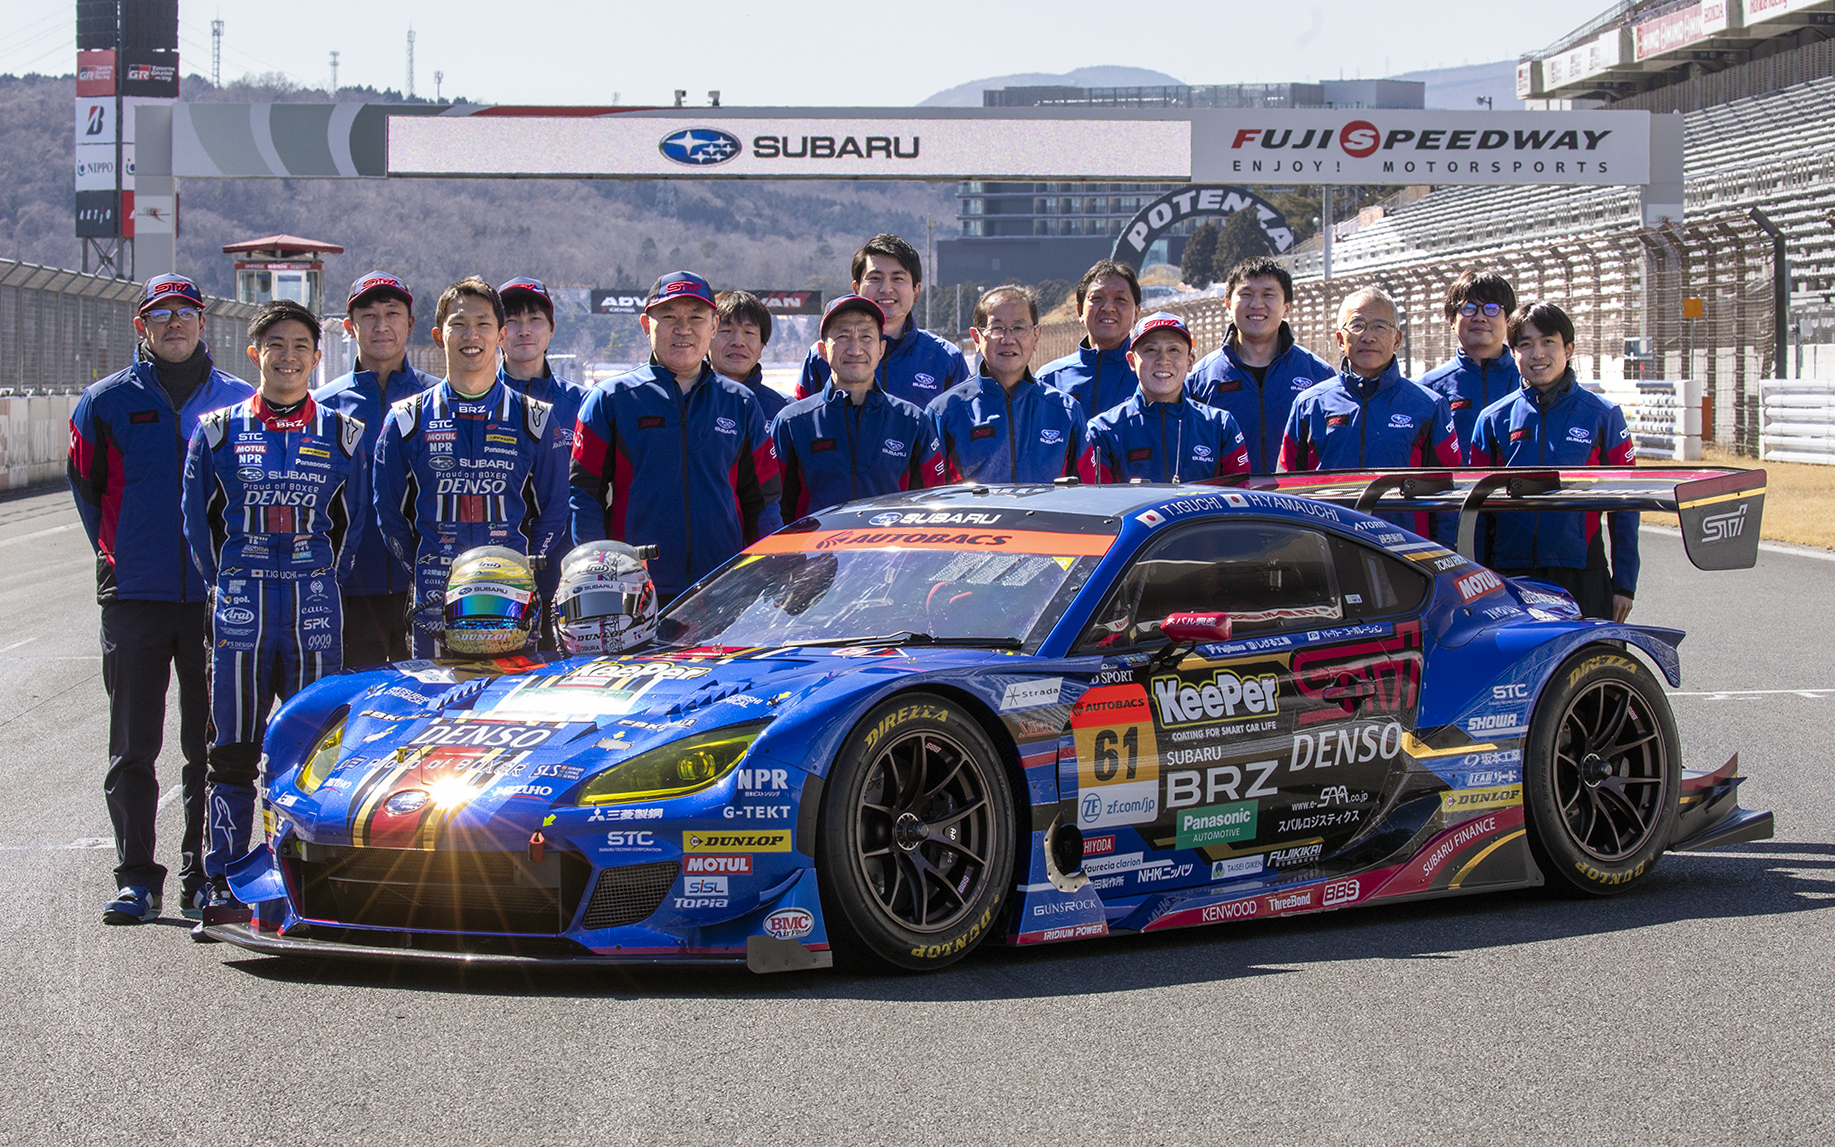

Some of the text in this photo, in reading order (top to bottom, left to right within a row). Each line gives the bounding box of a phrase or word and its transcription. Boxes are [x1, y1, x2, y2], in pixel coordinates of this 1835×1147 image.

[1703, 3, 1724, 24] HONDA
[1231, 129, 1336, 150] FUJI
[753, 136, 920, 159] SUBARU
[87, 162, 113, 173] NIPPO
[1233, 160, 1610, 174] ENJOY! MOTORSPORTS
[1126, 188, 1294, 255] POTENZA
[458, 405, 486, 414] BRZ
[276, 419, 304, 429] BRZ
[428, 420, 453, 429] STC
[238, 432, 264, 441] STC
[1566, 436, 1592, 444] SUBARU
[236, 445, 266, 453] MOTUL
[429, 443, 453, 452] NPR
[484, 446, 518, 456] Panasonic
[882, 448, 907, 457] SUBARU
[238, 454, 263, 464] NPR
[295, 458, 331, 469] Panasonic
[459, 458, 514, 470] SUBARU
[268, 470, 327, 483] SUBARU
[435, 470, 462, 478] Proud
[478, 470, 507, 480] BOXER
[289, 483, 319, 493] BOXER
[437, 479, 507, 494] DENSO
[244, 490, 317, 507] DENSO
[1160, 496, 1223, 516] T.IGUCHI
[1251, 494, 1341, 523] H.YAMAUCHI
[900, 513, 1001, 525] SUBARU
[847, 533, 1013, 546] AUTOBACS
[473, 586, 508, 595] SUBARU
[1458, 569, 1502, 600] MOTUL
[224, 607, 251, 620] Arai
[303, 617, 331, 630] SPK
[460, 633, 512, 641] DUNLOP
[577, 630, 627, 641] DUNLOP
[571, 661, 708, 681] KeePer
[1101, 669, 1133, 684] SPORT
[1567, 654, 1638, 690] DIREZZA
[1022, 688, 1059, 699] Strada
[1155, 673, 1277, 724] KeePer
[1493, 684, 1528, 699] STC
[1085, 699, 1145, 712] AUTOBACS
[864, 704, 949, 752] DIREZZA
[1467, 713, 1518, 731] SHOWA
[409, 725, 552, 748] DENSO
[1172, 721, 1276, 742] COATING FOR SMART CAR LIFE
[1094, 727, 1138, 782] 61
[1289, 722, 1404, 772] DENSO
[1166, 746, 1222, 766] SUBARU
[453, 758, 530, 777] BOXER
[533, 765, 562, 777] SLS
[737, 769, 788, 790] NPR
[1166, 760, 1279, 808] BRZ
[1458, 790, 1520, 805] DUNLOP
[606, 808, 663, 820] 三菱製鋼
[723, 806, 791, 819] G-TEKT
[1084, 797, 1155, 817] ZF zf.com/jp
[1184, 807, 1251, 831] Panasonic
[1278, 810, 1360, 832] スバルロジスティクス
[607, 831, 654, 846] STC
[705, 836, 784, 847] DUNLOP
[1193, 828, 1240, 842] AUTOMOTIVE
[1083, 838, 1112, 853] HIYODA
[1422, 817, 1496, 876] SUBARU FINANCE
[1266, 844, 1323, 867] FUJIKIKAI
[687, 858, 749, 871] MOTUL
[1084, 858, 1141, 874] faurecia clarion
[1227, 861, 1262, 873] TAISEI GIKEN
[1575, 860, 1645, 885] DUNLOP
[1322, 879, 1360, 906] BBS
[1033, 899, 1097, 916] GUNSROCK
[1202, 892, 1310, 922] KENWOOD ThreeBond
[770, 916, 809, 930] BMC
[911, 906, 993, 959] DUNLOP
[1043, 925, 1103, 940] IRIDIUM POWER
